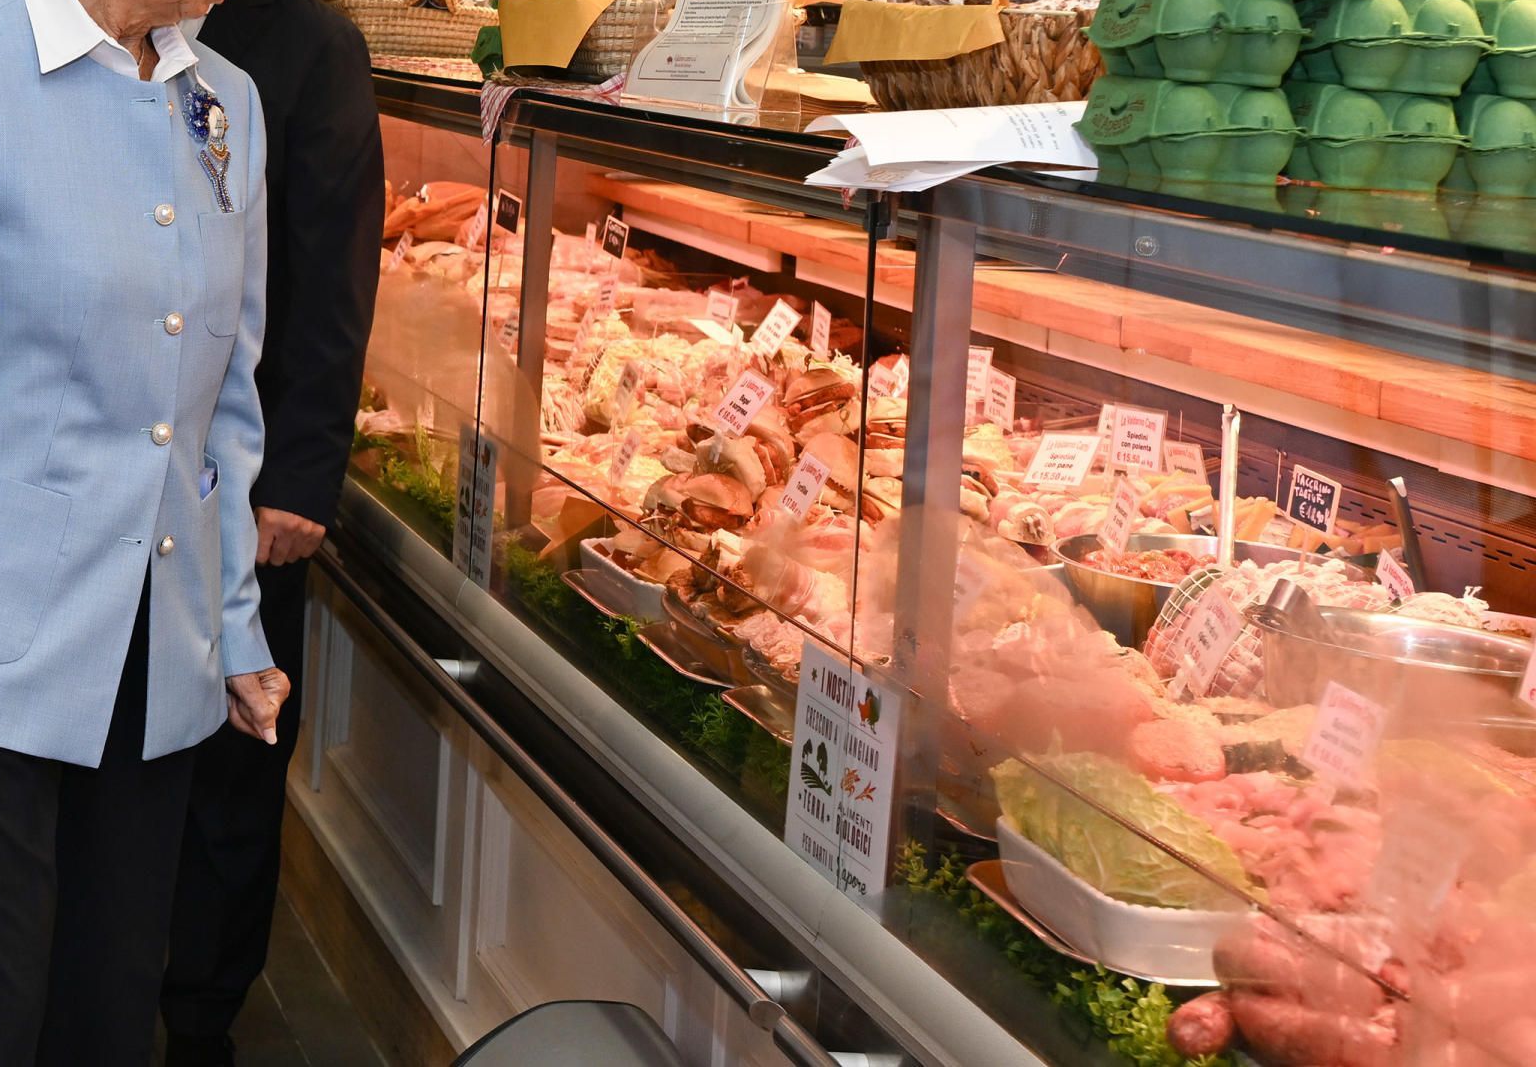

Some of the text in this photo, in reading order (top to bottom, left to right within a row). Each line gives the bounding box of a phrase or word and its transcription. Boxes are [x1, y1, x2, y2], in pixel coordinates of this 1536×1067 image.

[1126, 431, 1149, 441] Spiedini
[803, 788, 826, 824] TERRA
[837, 801, 874, 834] ALIMENTI
